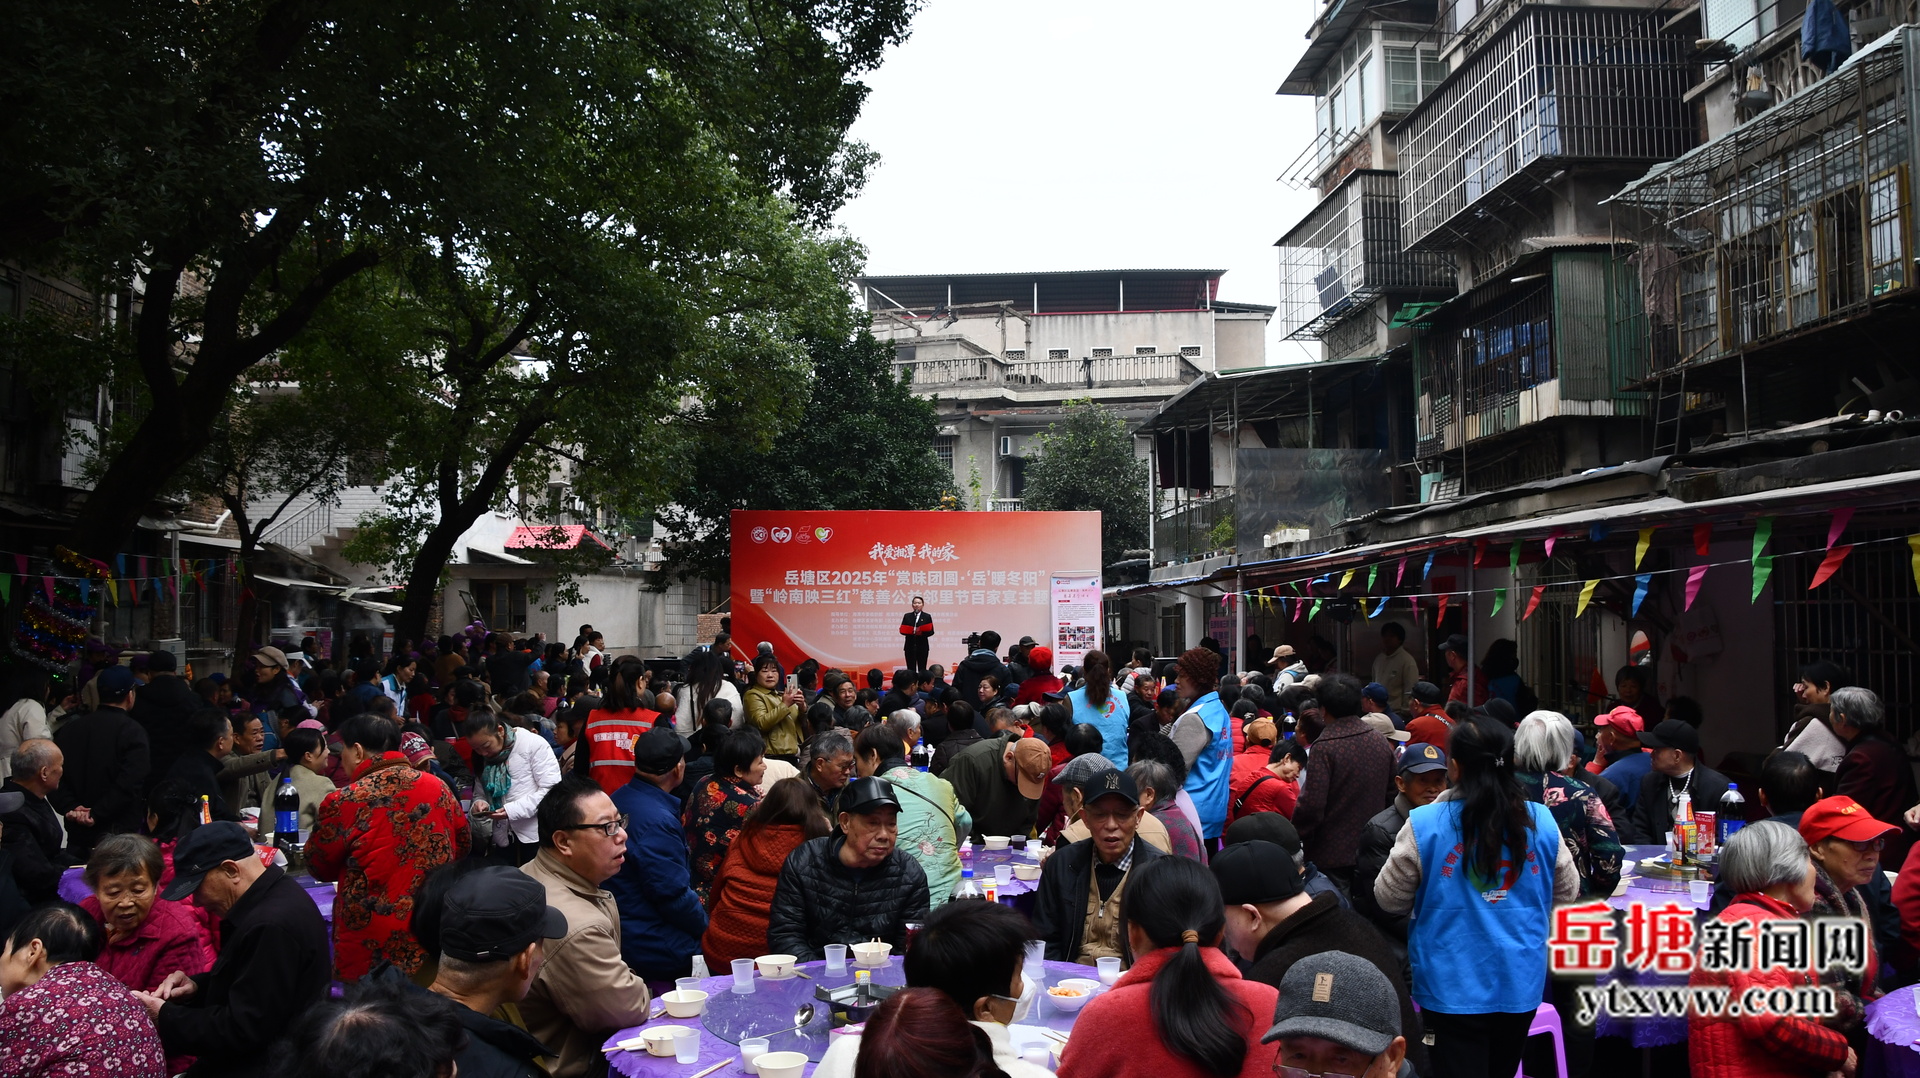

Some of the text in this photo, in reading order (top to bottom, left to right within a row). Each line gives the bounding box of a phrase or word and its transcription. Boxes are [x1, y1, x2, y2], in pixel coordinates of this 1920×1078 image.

[868, 542, 960, 566] 我爱湘潭 我的家
